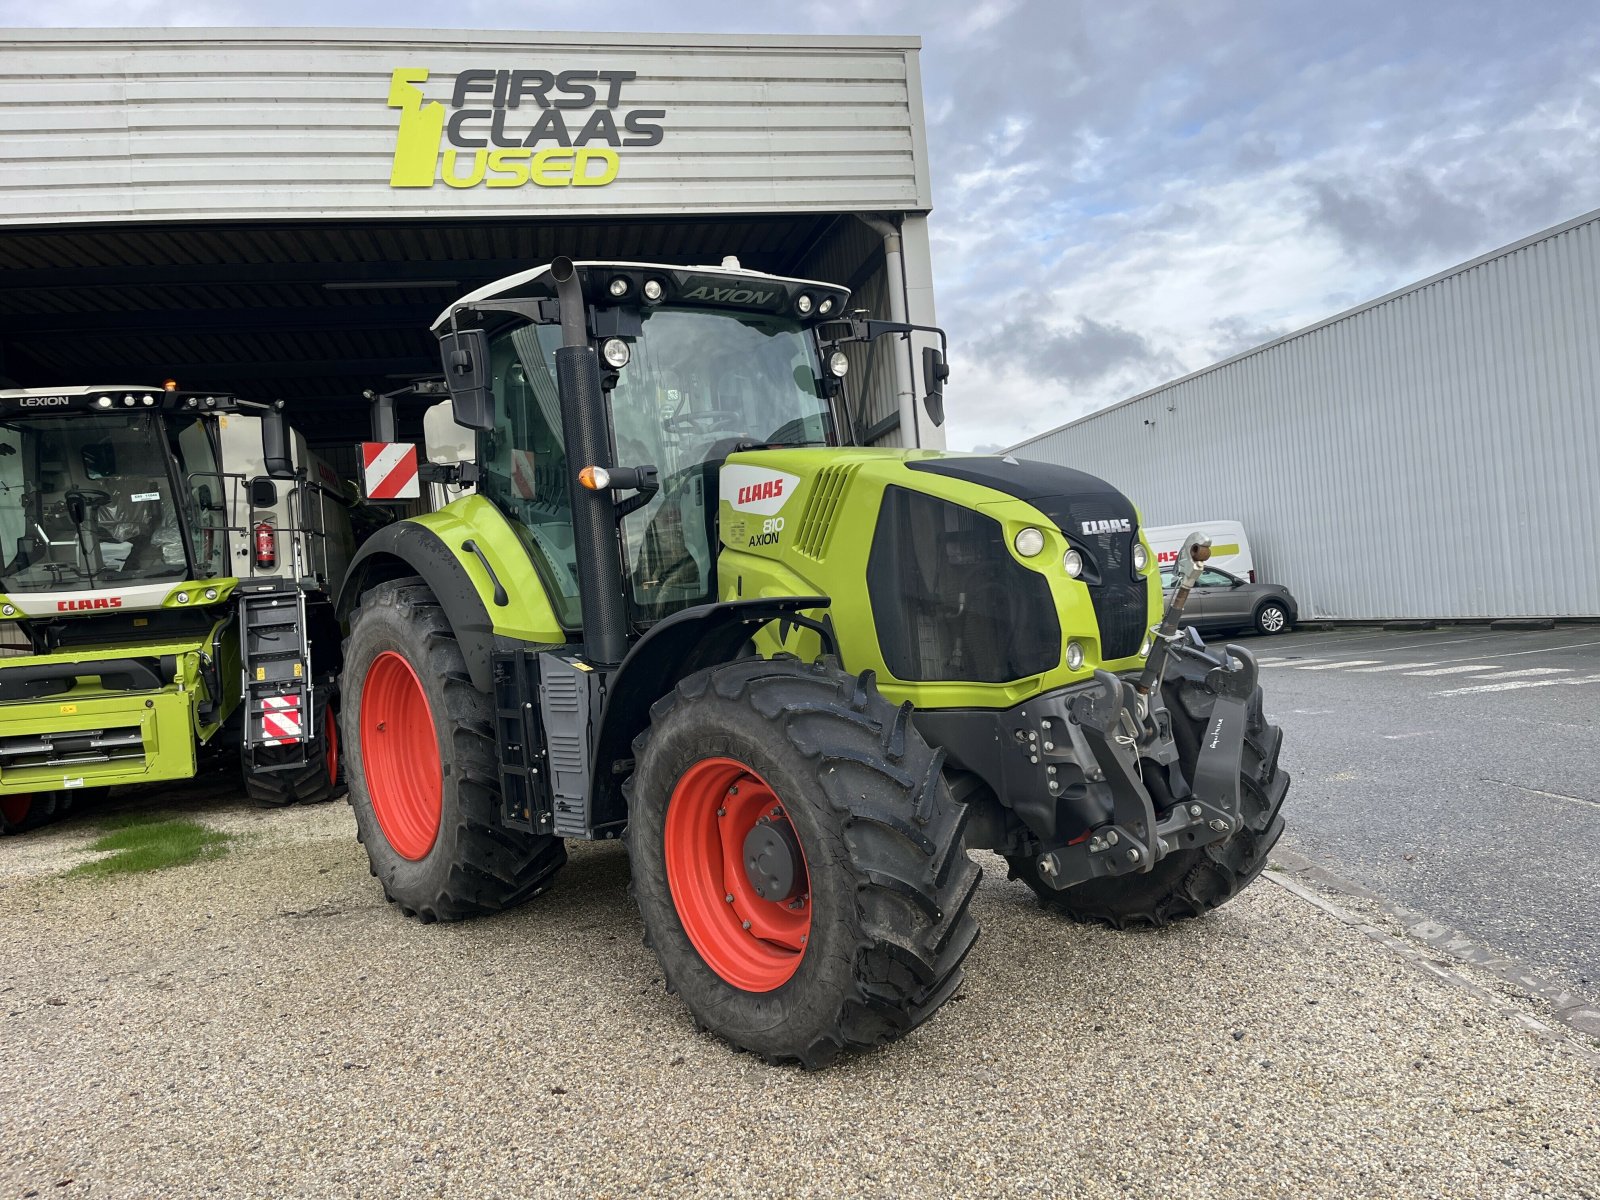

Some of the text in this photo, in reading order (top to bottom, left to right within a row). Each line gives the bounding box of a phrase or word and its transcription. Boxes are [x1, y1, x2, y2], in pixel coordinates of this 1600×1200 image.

[452, 69, 636, 107] FIRST
[447, 109, 666, 147] CLAAS
[441, 148, 620, 188] USED
[685, 287, 773, 304] AXION
[20, 396, 69, 406] LEXION
[738, 479, 783, 504] CLAAS
[763, 517, 784, 533] 810
[1082, 519, 1131, 535] CLAAS
[749, 532, 780, 547] AXION
[57, 597, 122, 611] CLAAS
